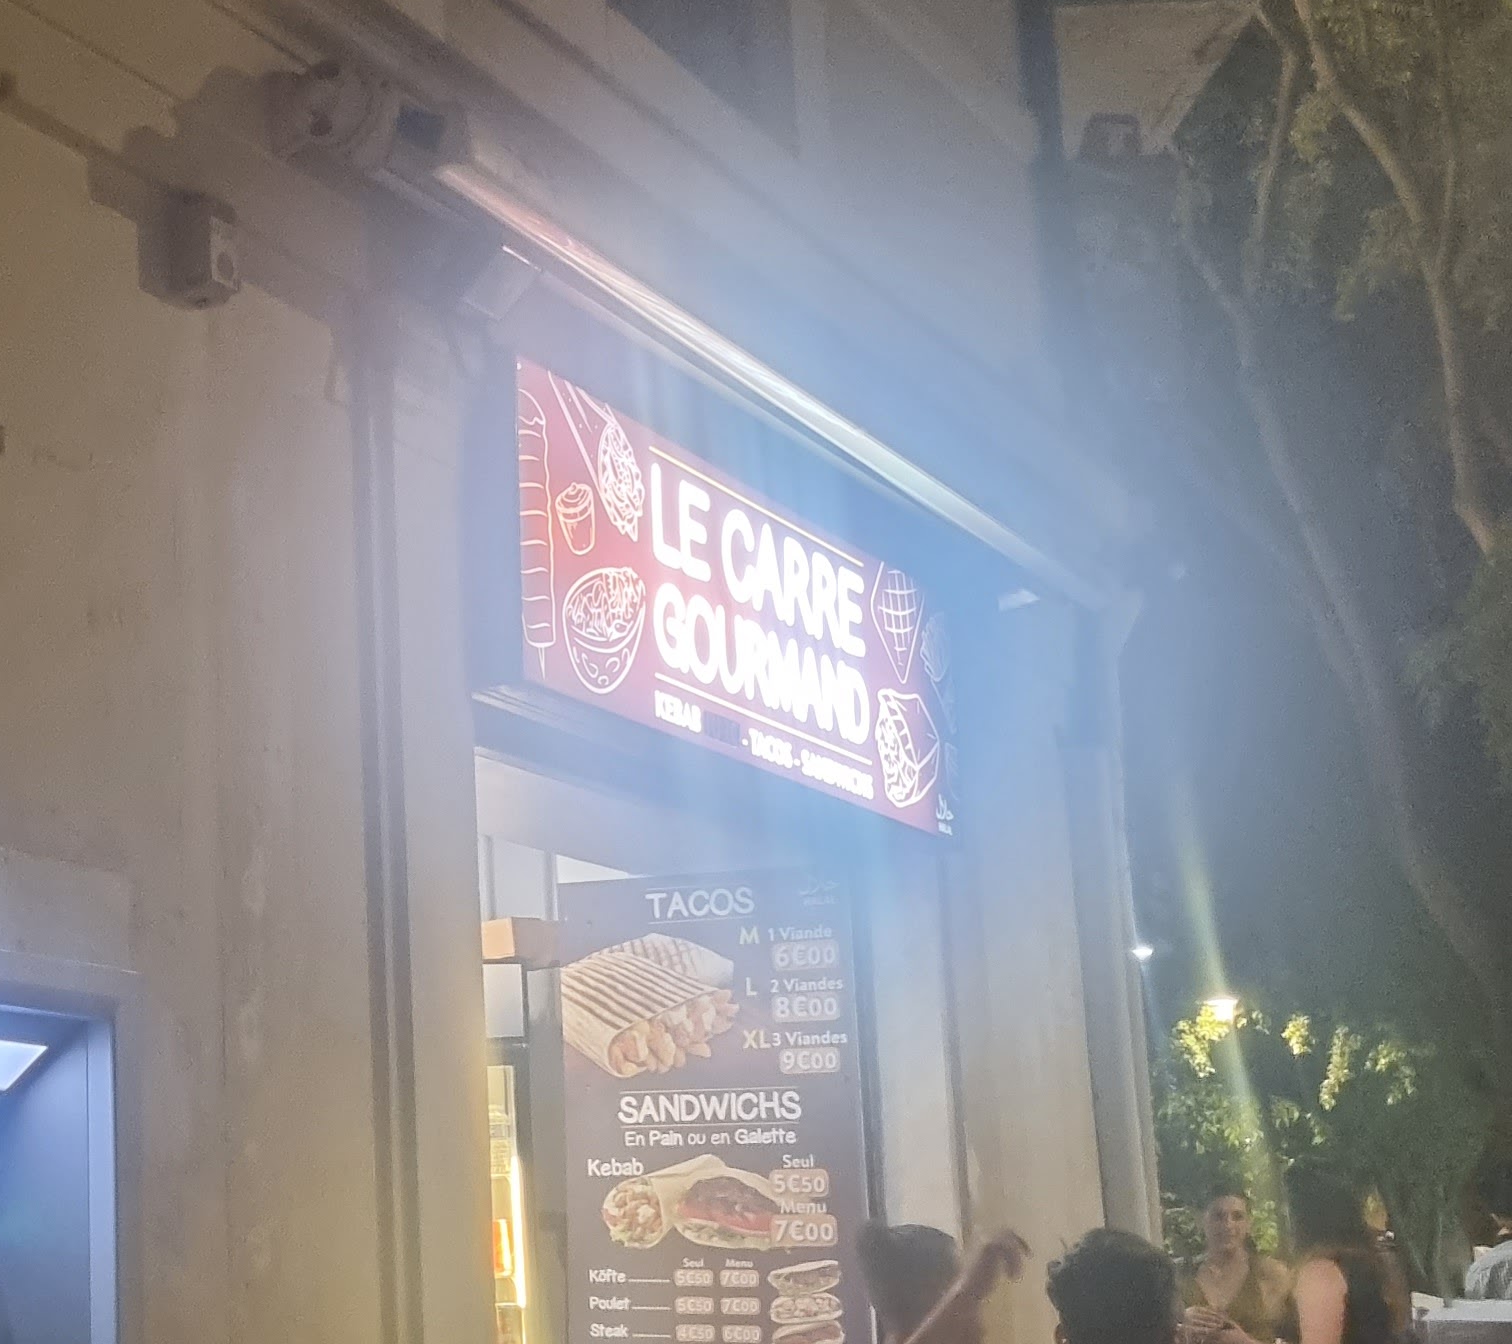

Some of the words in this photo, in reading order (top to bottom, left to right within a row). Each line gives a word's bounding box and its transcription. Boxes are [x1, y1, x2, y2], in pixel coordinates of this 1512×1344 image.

[651, 462, 711, 582] LE
[721, 508, 866, 658] CARRE
[652, 582, 871, 745] GOURMAND
[748, 727, 794, 769] TACOS
[645, 887, 756, 919] TACOS
[739, 926, 760, 945] M
[768, 928, 774, 942] 1
[779, 925, 832, 941] Viande
[775, 945, 836, 967] 6€00
[745, 977, 758, 996] L
[770, 979, 780, 993] 2
[783, 977, 843, 993] Viandes
[776, 996, 837, 1018] 8€00
[742, 1030, 772, 1049] XL
[772, 1032, 781, 1047] 3
[785, 1031, 848, 1046] Viandes
[781, 1051, 837, 1071] 9€00
[617, 1090, 802, 1124] SANDWICHS
[624, 1131, 646, 1147] En
[649, 1130, 683, 1147] Pain
[687, 1132, 706, 1145] ou
[710, 1132, 731, 1145] en
[734, 1128, 798, 1145] Galette
[587, 1158, 644, 1177] Kebab
[782, 1154, 814, 1169] Seul
[773, 1174, 826, 1193] 5€50
[780, 1200, 827, 1215] Menu
[775, 1222, 835, 1242] 7€00
[682, 1257, 705, 1268] Seul
[725, 1258, 754, 1269] Menu
[589, 1296, 631, 1310] Poulet
[590, 1323, 629, 1338] Steak
